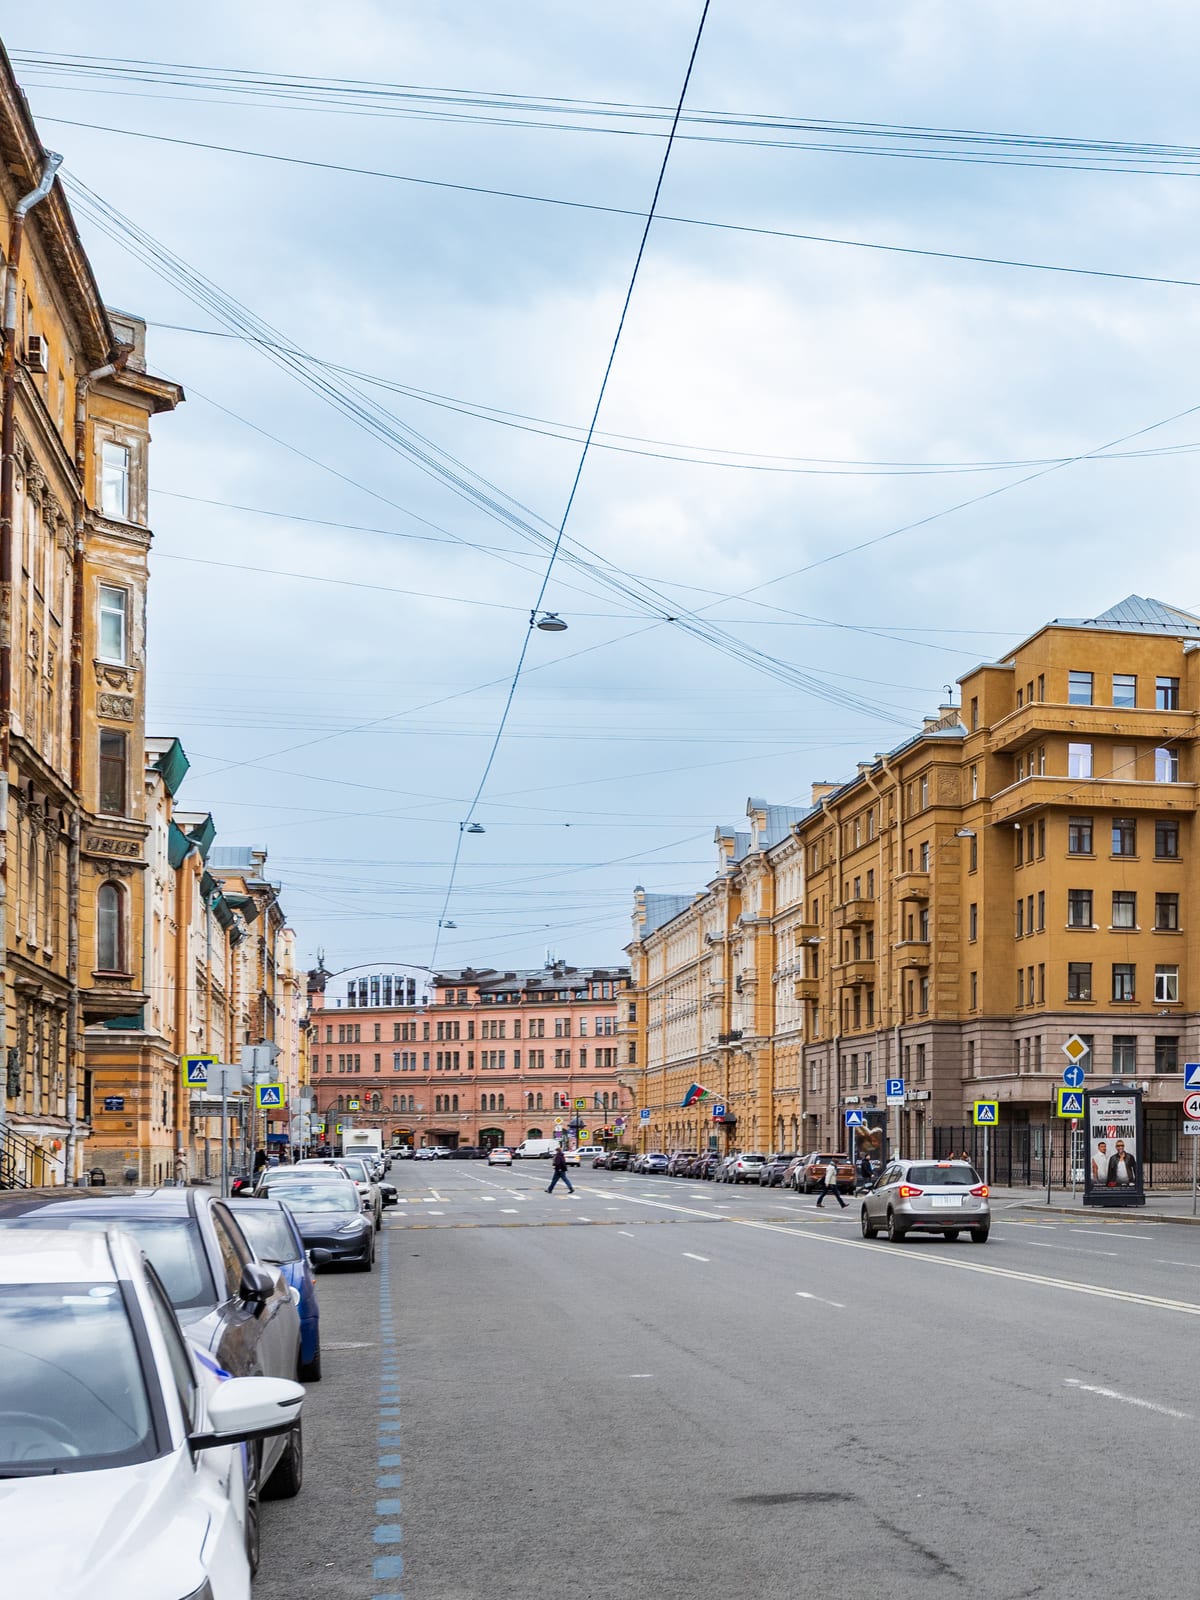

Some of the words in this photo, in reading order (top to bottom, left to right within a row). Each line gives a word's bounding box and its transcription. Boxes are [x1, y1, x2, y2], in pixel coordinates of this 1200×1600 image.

[891, 1081, 901, 1094] P
[716, 1106, 723, 1115] P
[1092, 1125, 1135, 1139] UMA22RMAN
